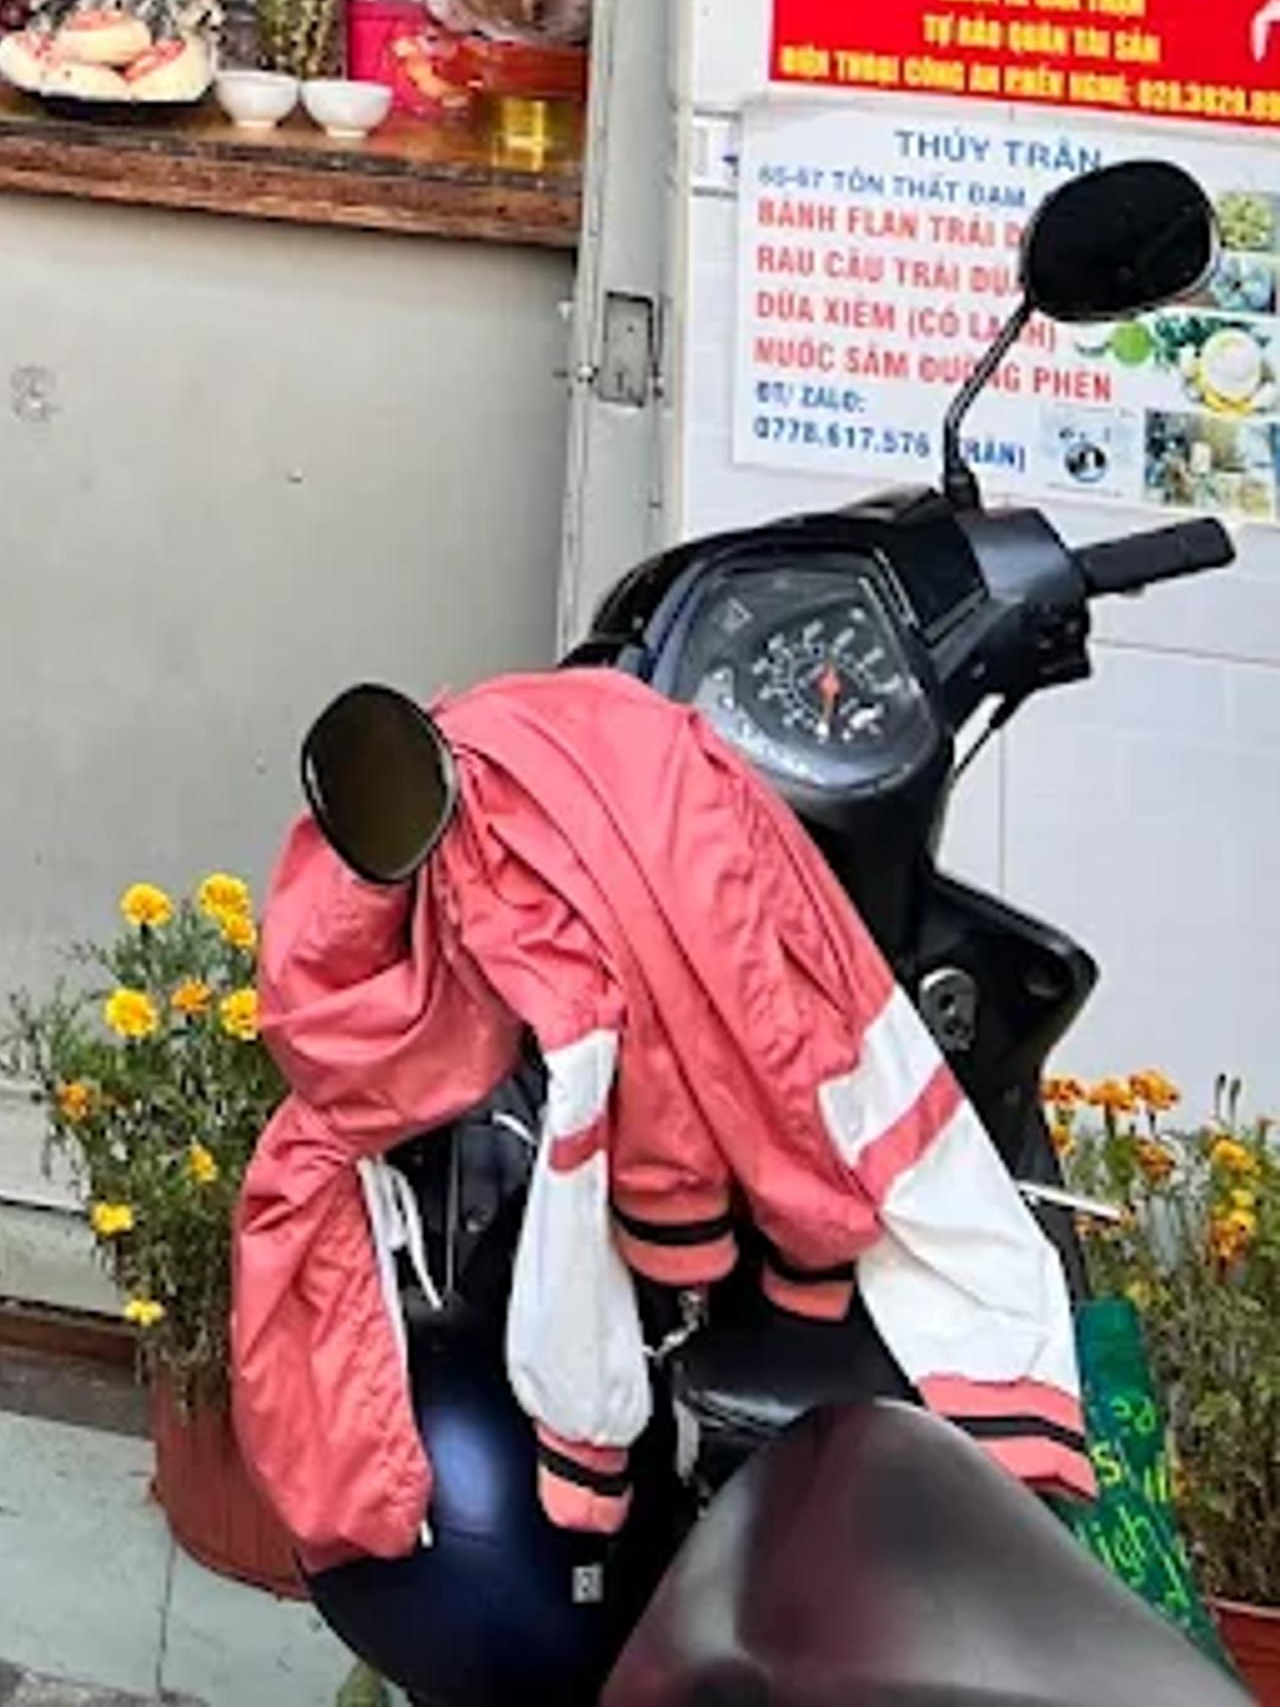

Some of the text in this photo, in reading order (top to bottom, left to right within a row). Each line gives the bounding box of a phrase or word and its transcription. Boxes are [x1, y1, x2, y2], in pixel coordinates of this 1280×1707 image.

[845, 204, 921, 240] FLAN
[756, 244, 817, 279] RAU
[893, 252, 963, 292] TRÁI
